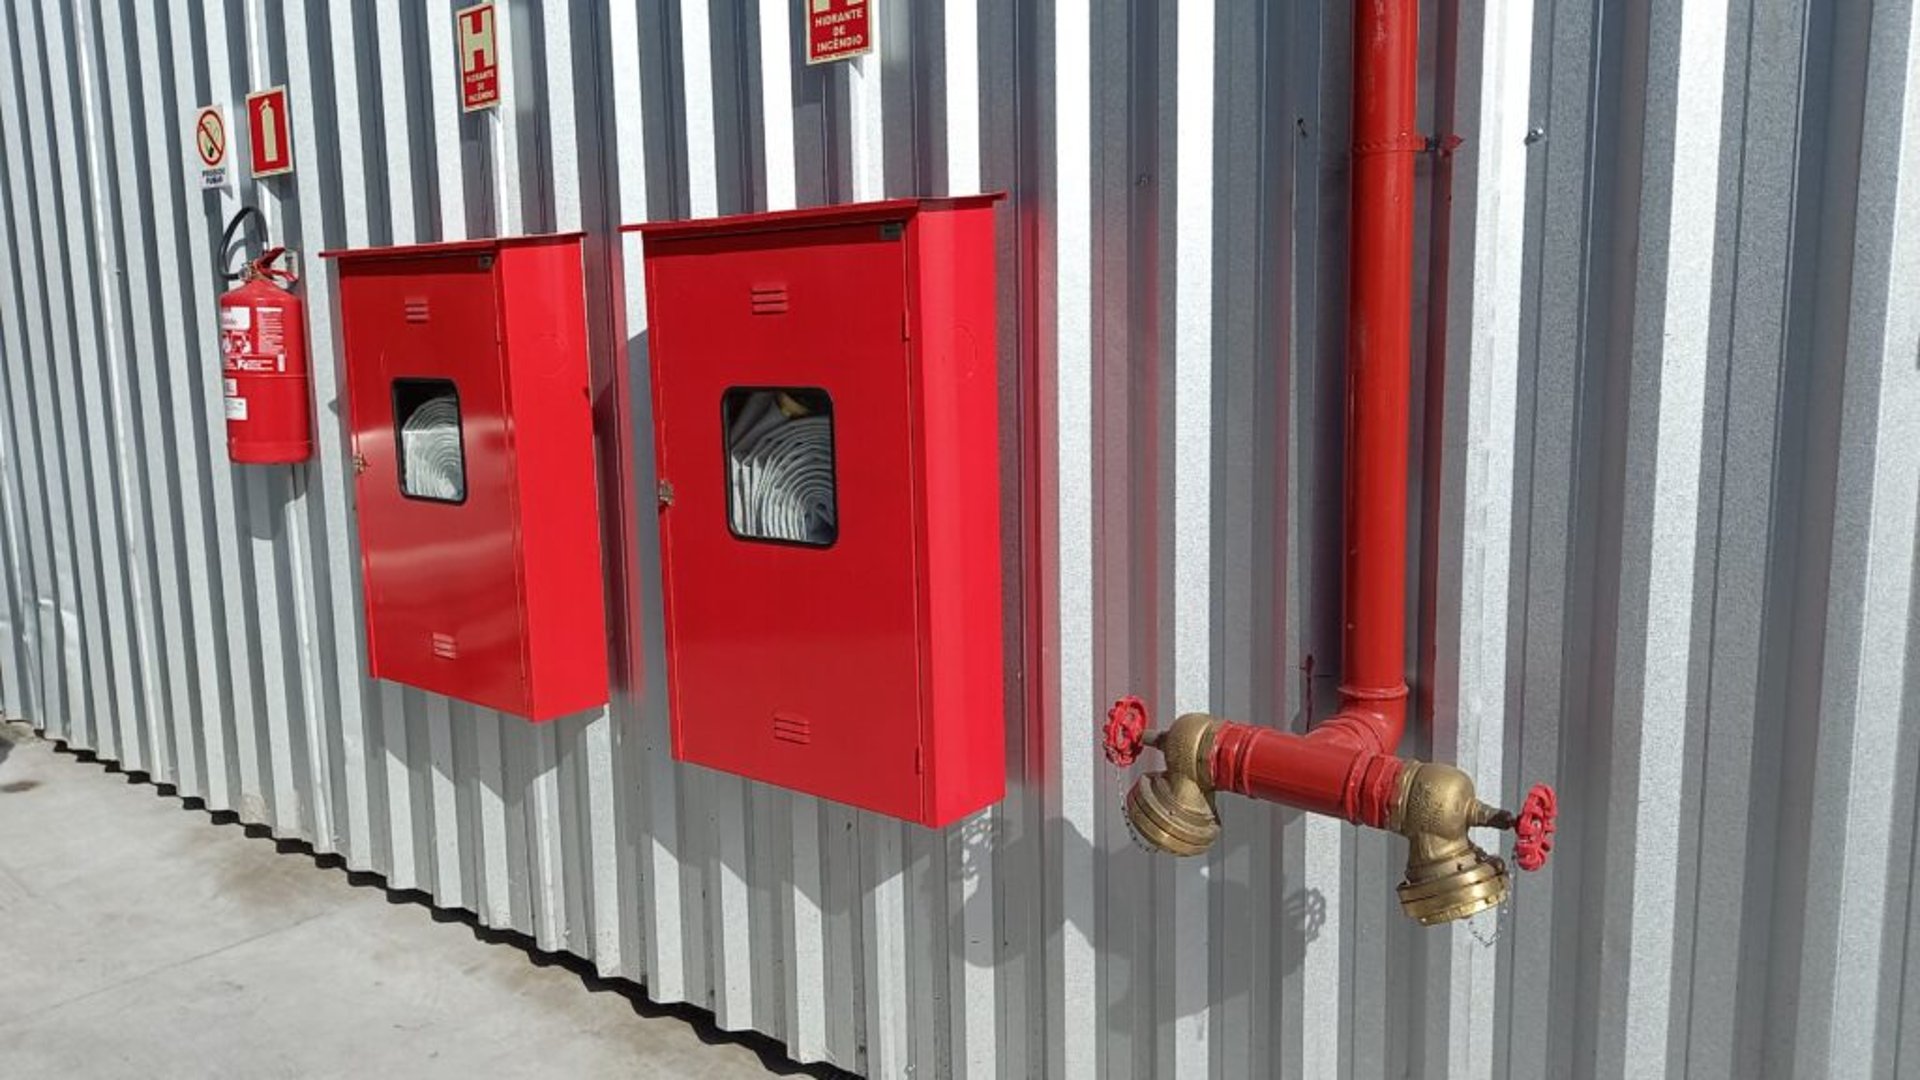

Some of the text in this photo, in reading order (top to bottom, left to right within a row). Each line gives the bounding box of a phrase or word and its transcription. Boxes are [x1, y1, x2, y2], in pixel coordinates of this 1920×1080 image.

[815, 8, 864, 27] HIDRANTE
[832, 25, 847, 36] DE
[462, 9, 495, 73] H
[817, 34, 863, 53] INCÊNDIO
